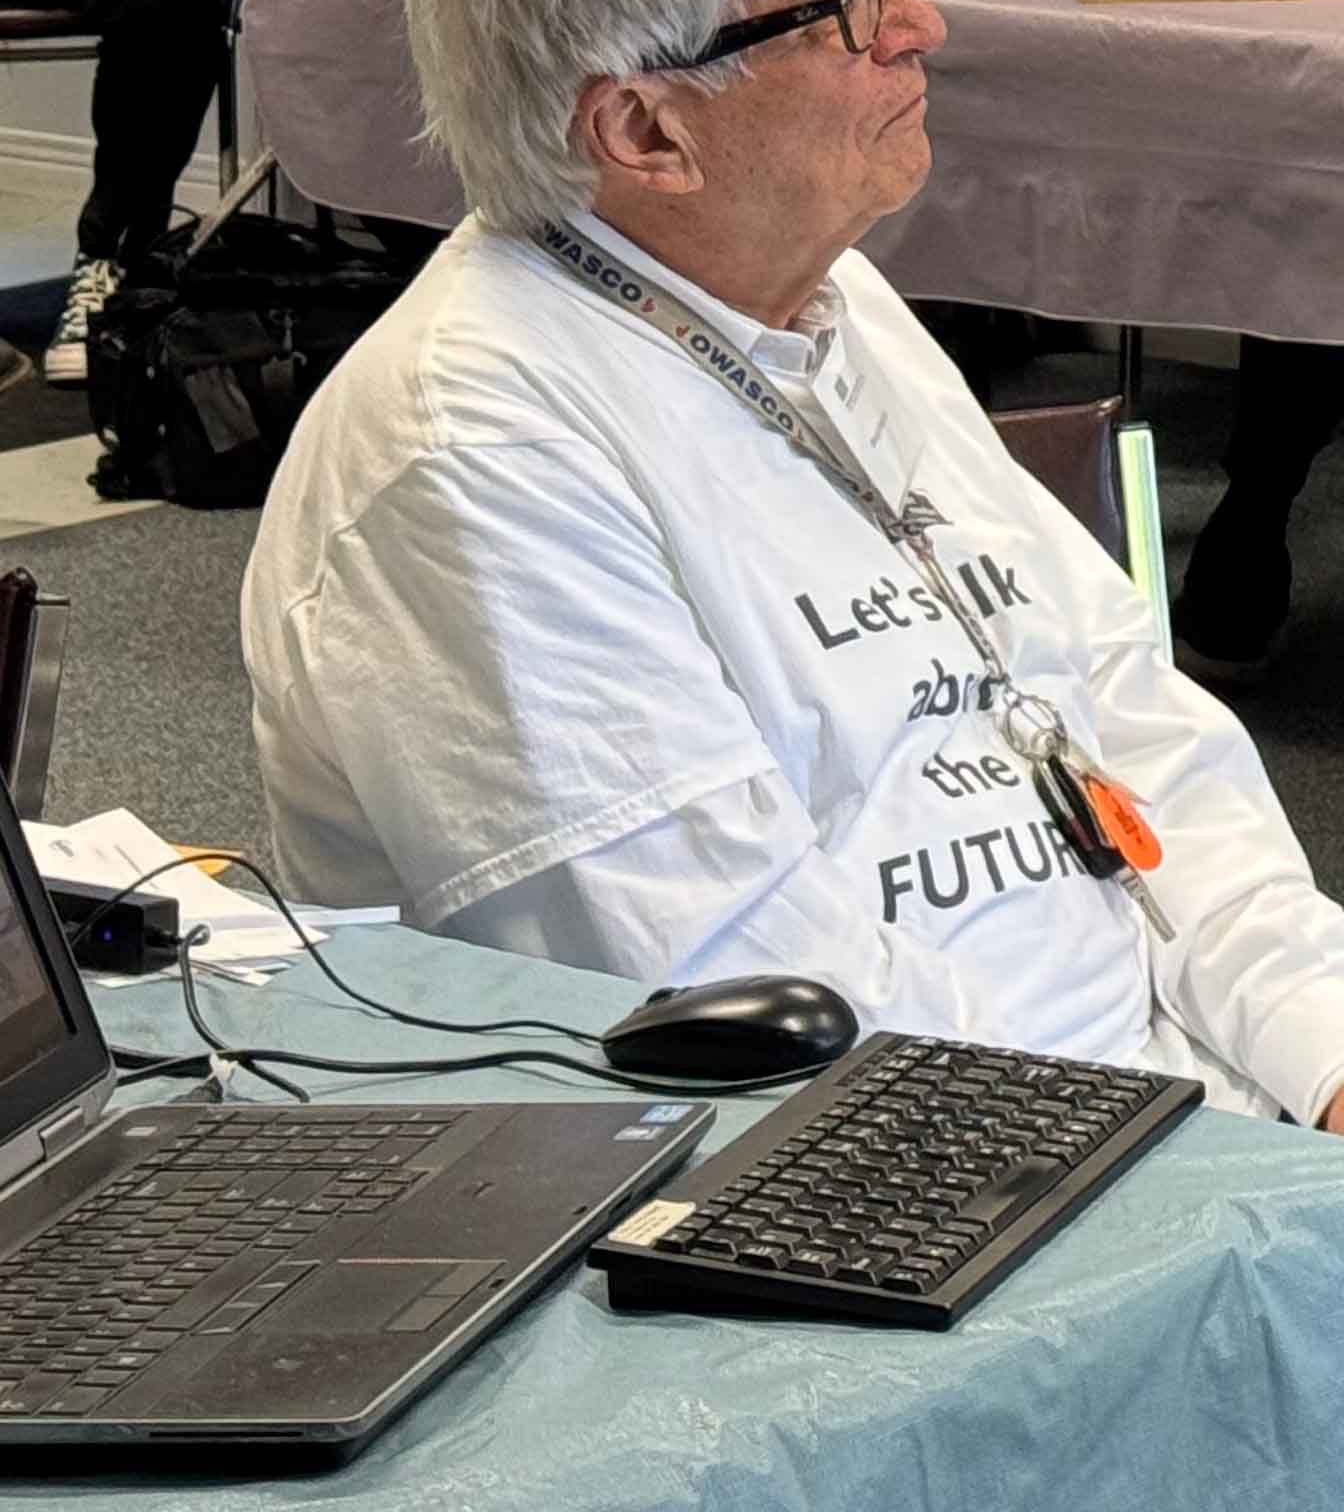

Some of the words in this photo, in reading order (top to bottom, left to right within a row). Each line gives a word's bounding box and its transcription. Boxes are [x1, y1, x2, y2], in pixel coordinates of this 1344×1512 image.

[544, 223, 643, 303] WASCO
[690, 334, 794, 431] OWASCO
[795, 577, 943, 650] Let's
[957, 553, 1033, 619] lk
[922, 752, 1021, 799] the
[878, 821, 1088, 925] FUTUR
